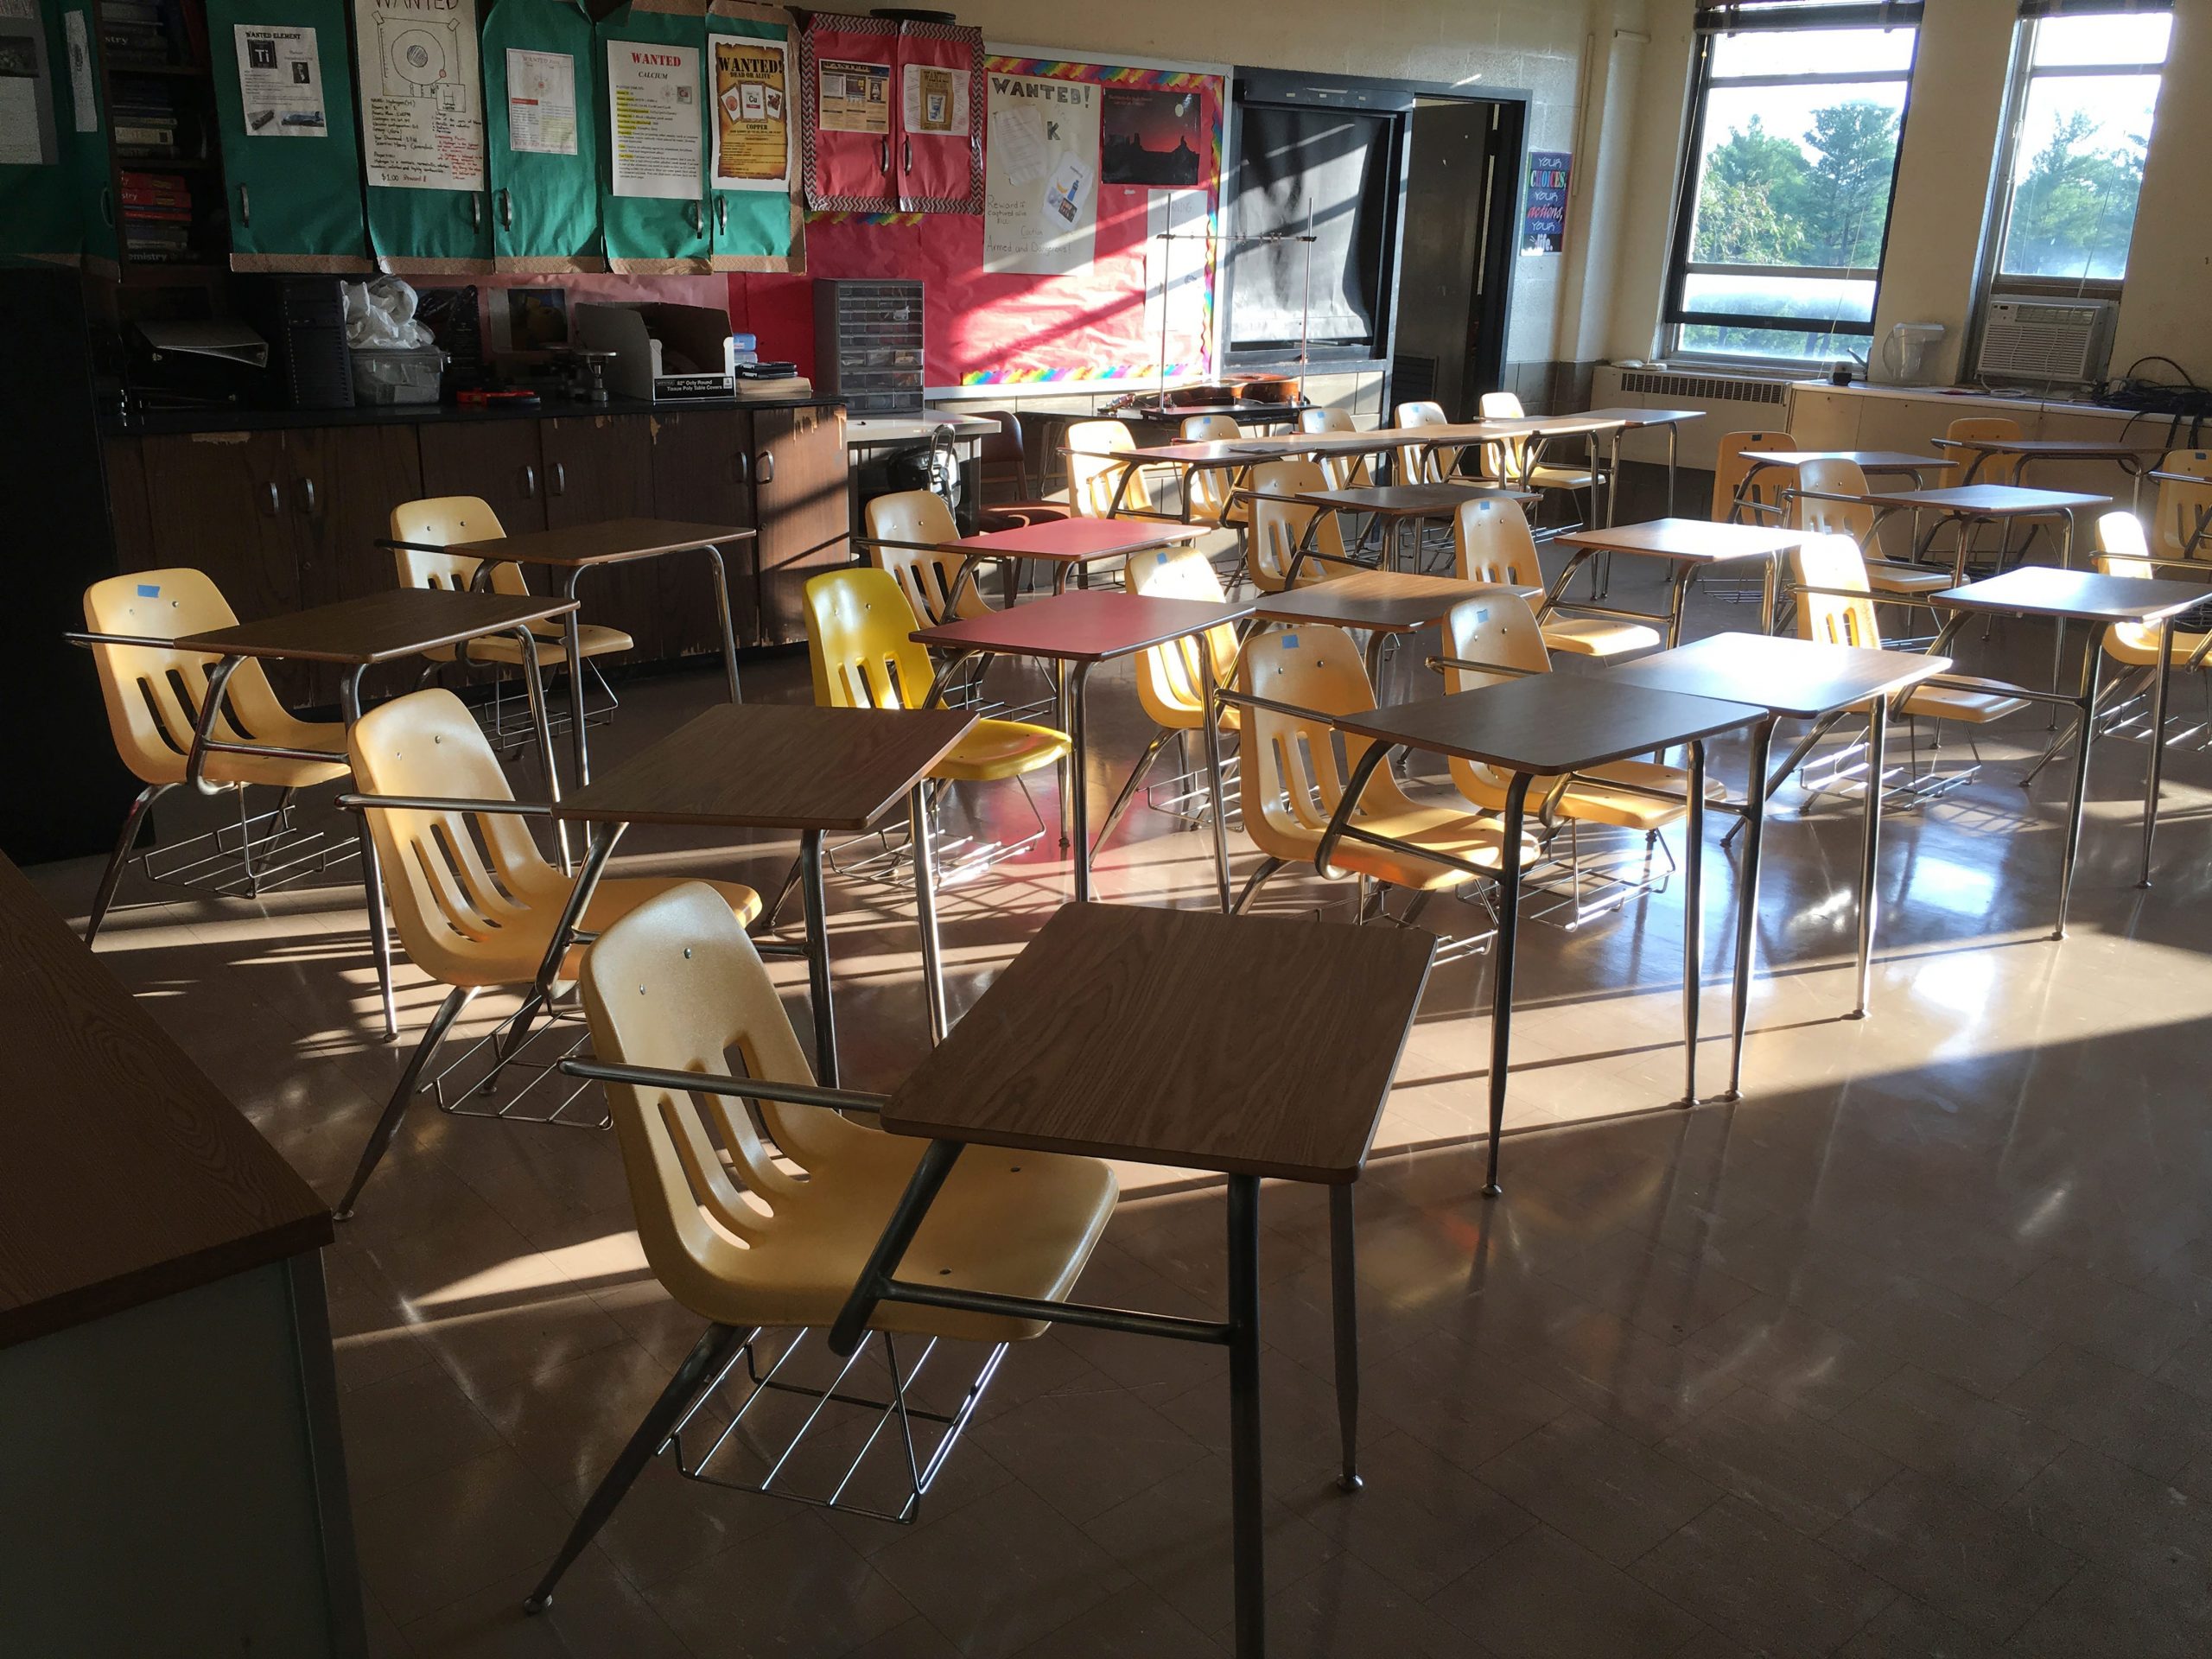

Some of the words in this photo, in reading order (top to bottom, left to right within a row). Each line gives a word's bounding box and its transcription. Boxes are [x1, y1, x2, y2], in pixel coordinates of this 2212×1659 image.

[255, 50, 270, 63] Ti
[631, 52, 682, 67] WANTED
[718, 57, 783, 74] WANTED!
[638, 71, 669, 79] CALCIUM
[679, 89, 690, 98] Ca
[748, 95, 758, 105] Cu
[991, 77, 1091, 109] WANTED!
[1046, 121, 1061, 141] K
[1538, 156, 1562, 169] YOUR
[1530, 170, 1567, 191] CHOICES,
[987, 194, 1019, 209] Reward
[1535, 190, 1559, 202] YOUR
[987, 209, 1014, 218] captured
[1528, 204, 1563, 222] actions,
[1532, 220, 1555, 232] YOUR
[987, 235, 1012, 252] Armed
[1014, 242, 1028, 252] and
